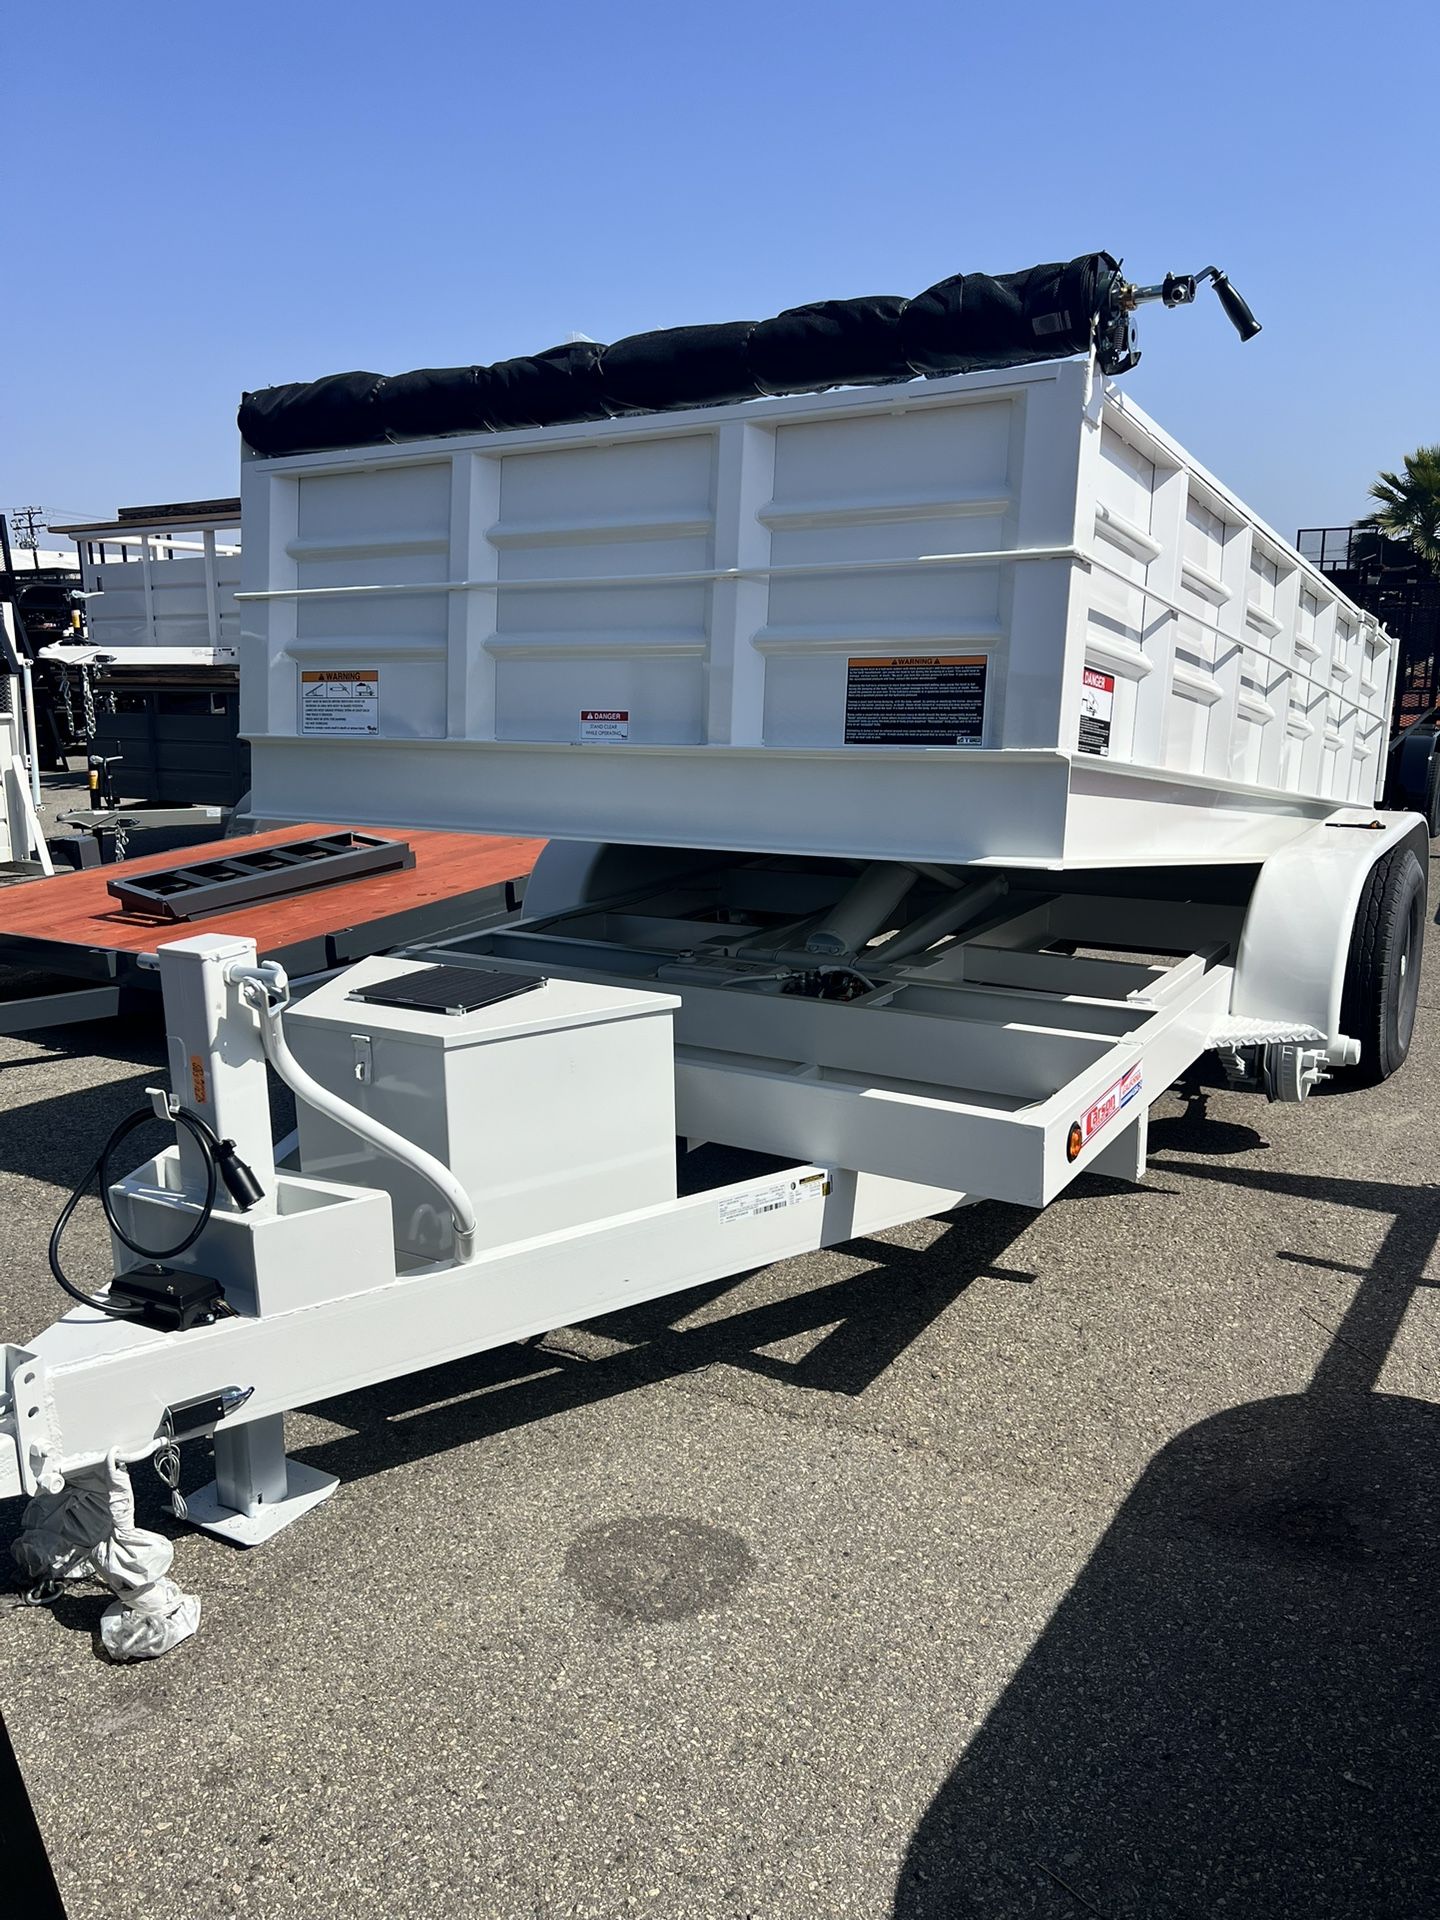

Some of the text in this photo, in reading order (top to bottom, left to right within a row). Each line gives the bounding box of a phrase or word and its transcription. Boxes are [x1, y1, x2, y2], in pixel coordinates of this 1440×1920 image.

[326, 672, 361, 680] WARNING
[594, 712, 621, 720] DANGER
[1086, 1095, 1115, 1135] Carson
